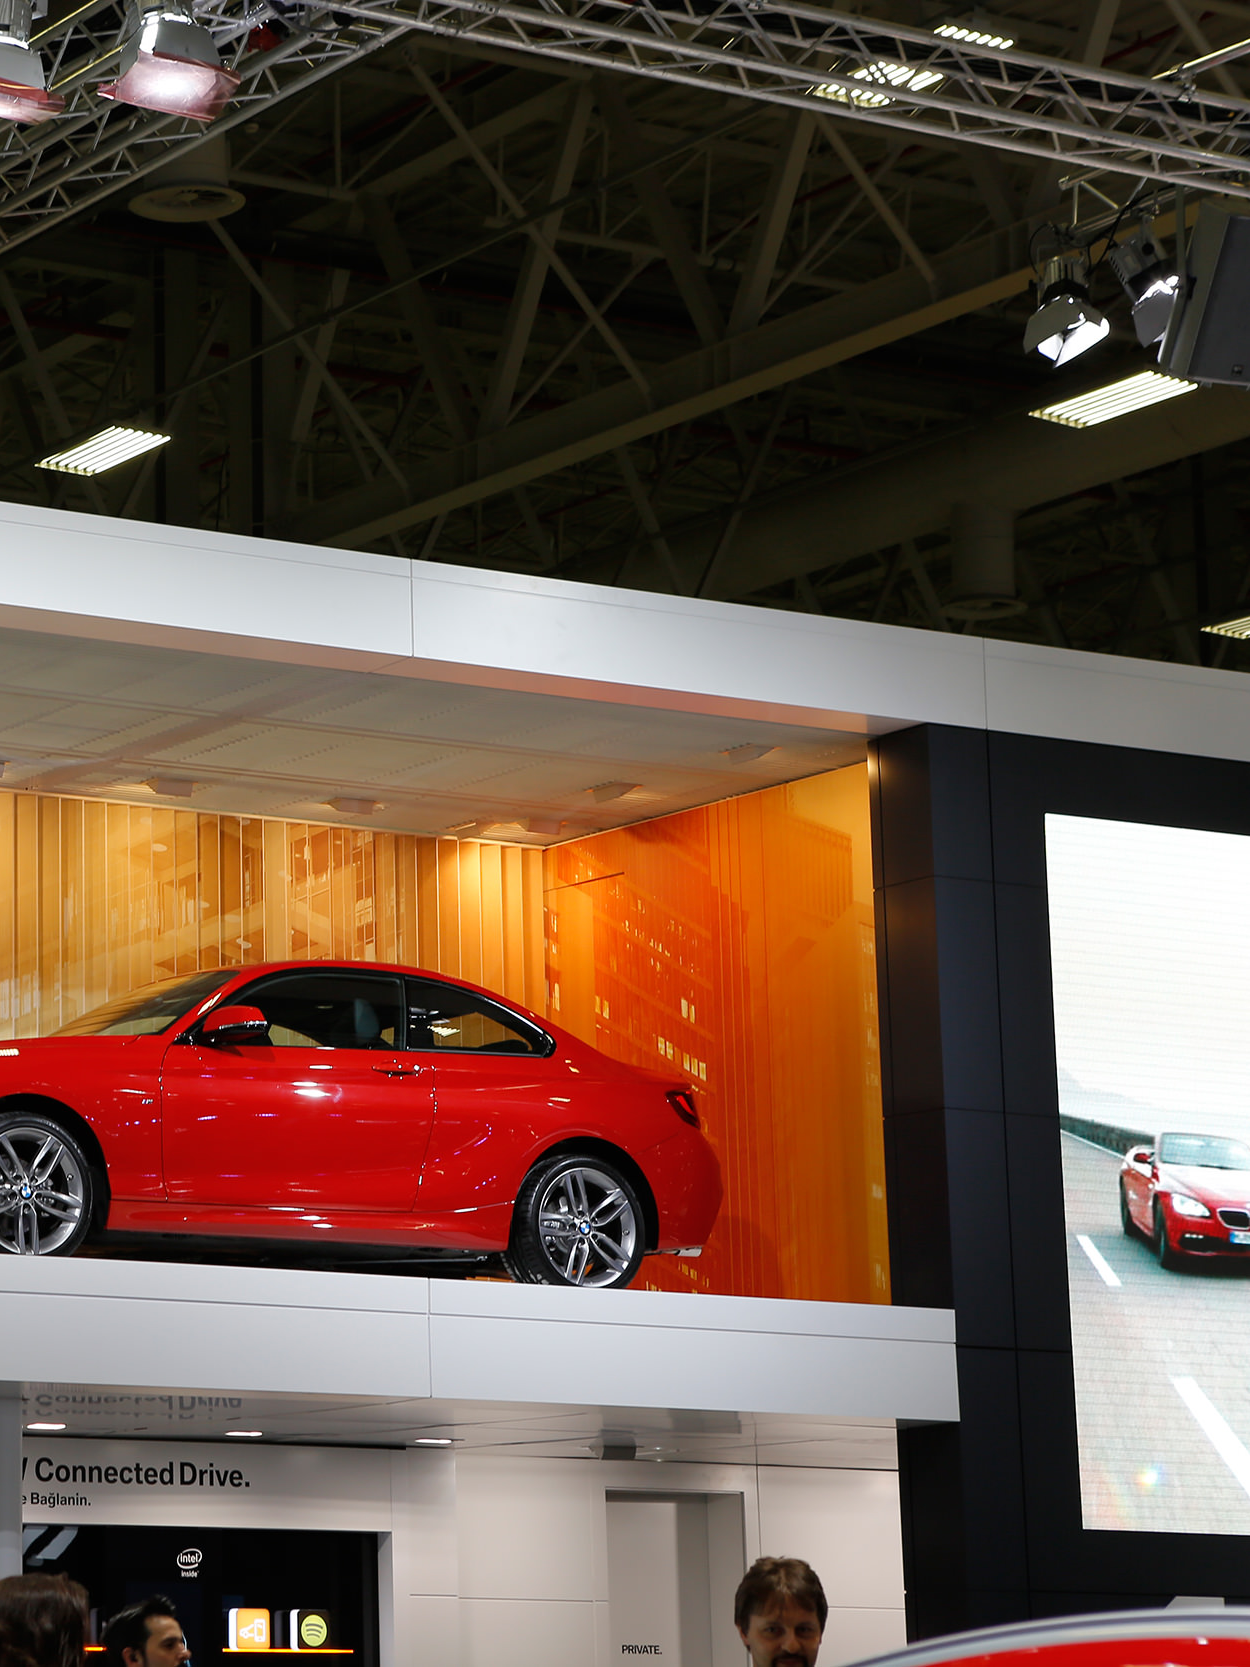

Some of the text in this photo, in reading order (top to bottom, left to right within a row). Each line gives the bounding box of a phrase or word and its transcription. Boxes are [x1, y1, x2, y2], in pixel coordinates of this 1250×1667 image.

[35, 1457, 174, 1485] Connected
[180, 1462, 251, 1488] Drive.
[180, 1553, 199, 1563] intel
[622, 1644, 663, 1655] PRIVATE.
